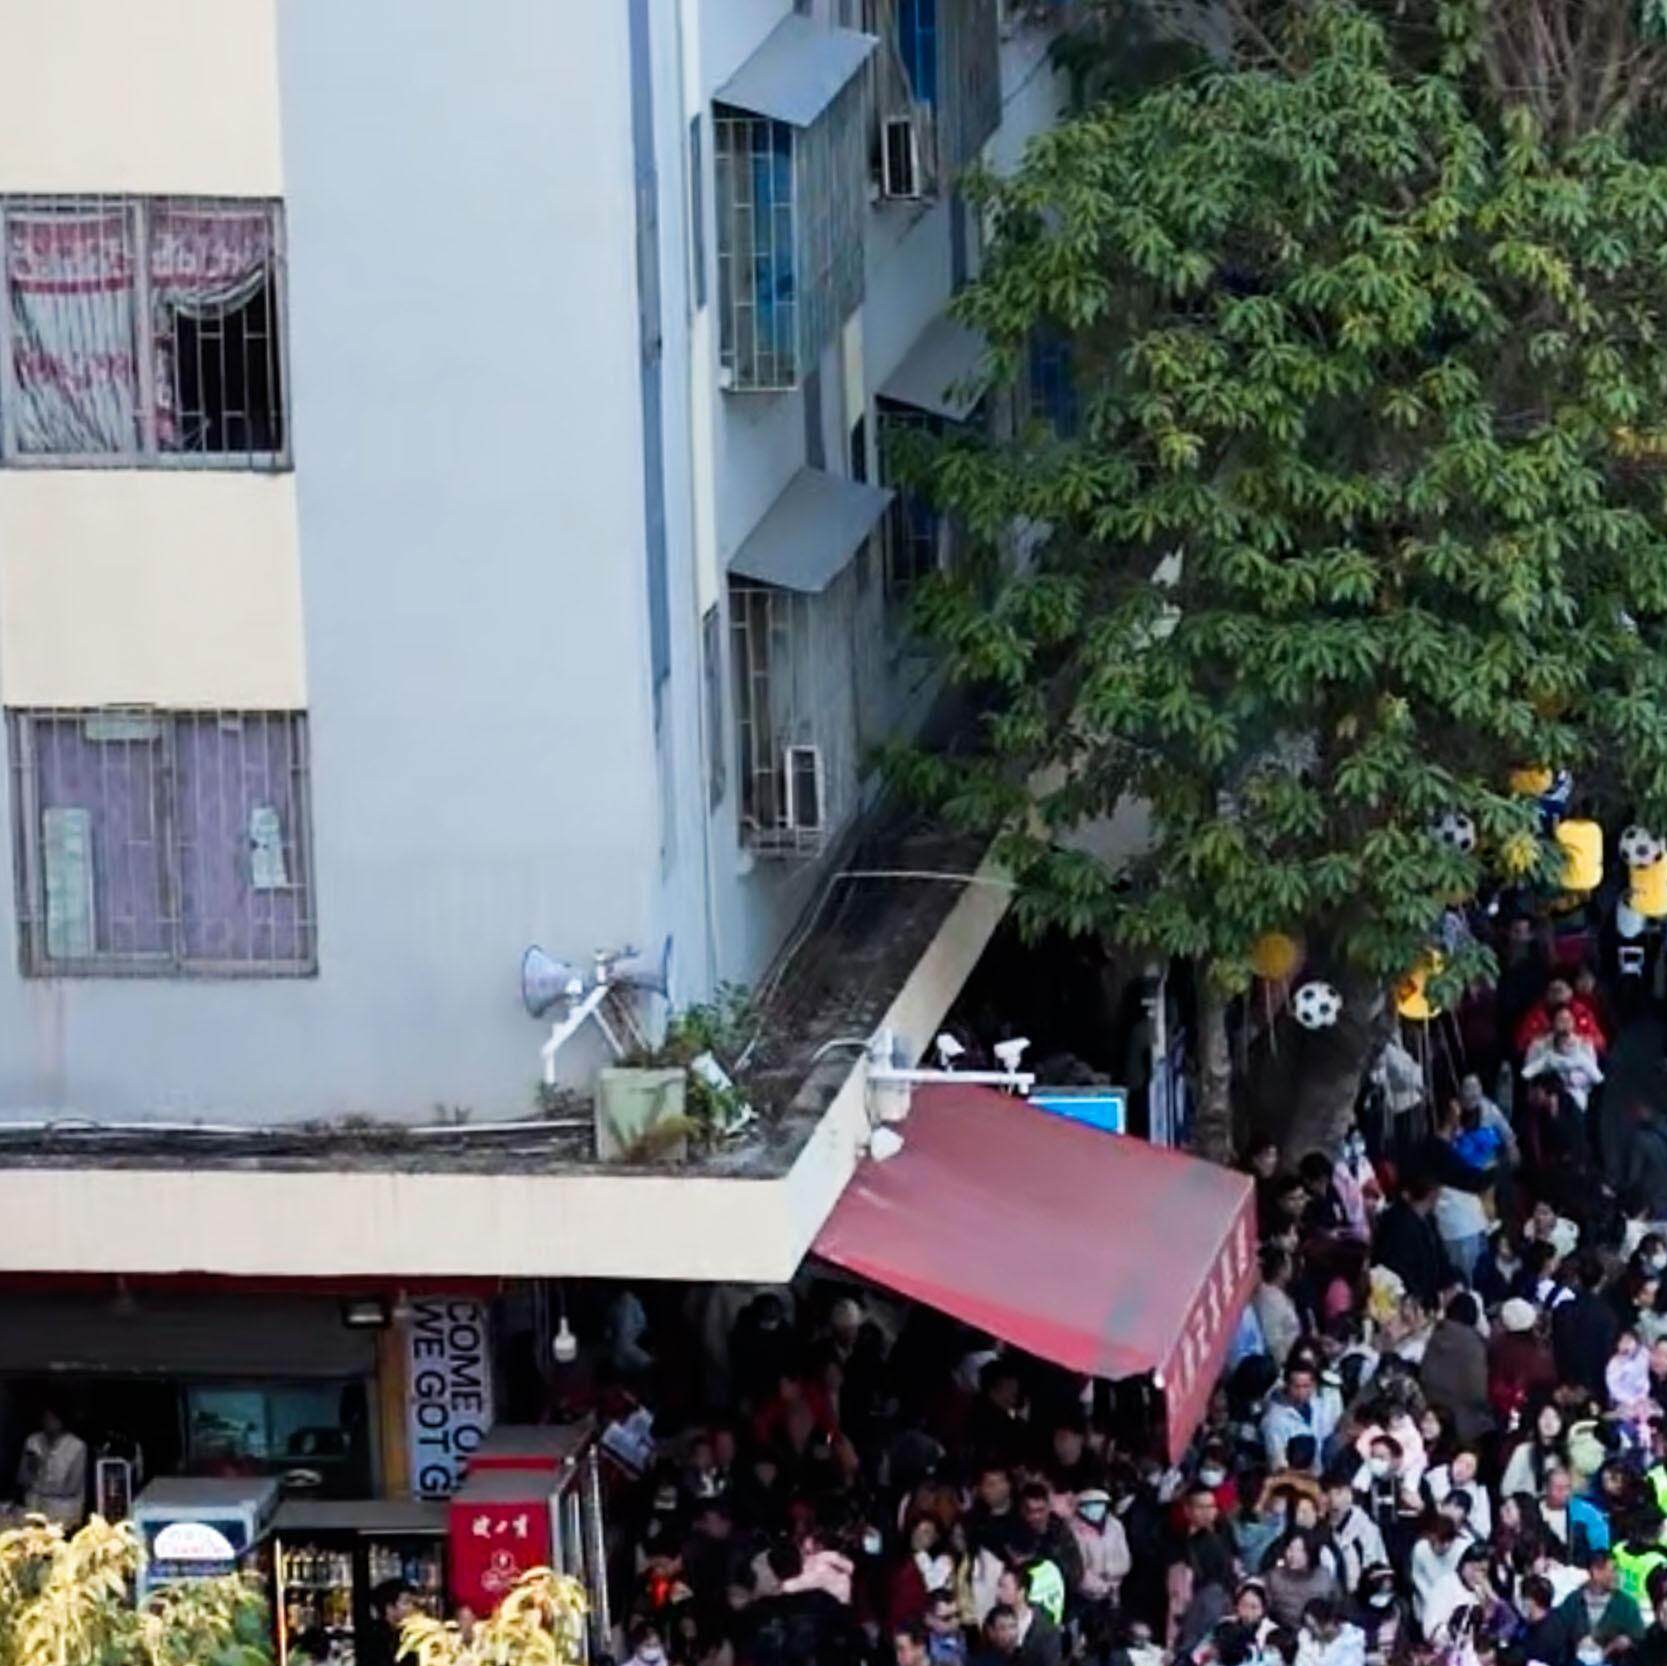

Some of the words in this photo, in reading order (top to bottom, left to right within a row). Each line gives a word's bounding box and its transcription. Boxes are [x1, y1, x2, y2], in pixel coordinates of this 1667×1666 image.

[413, 1302, 444, 1359] WE
[448, 1302, 482, 1413] COME
[415, 1371, 449, 1453] GOT
